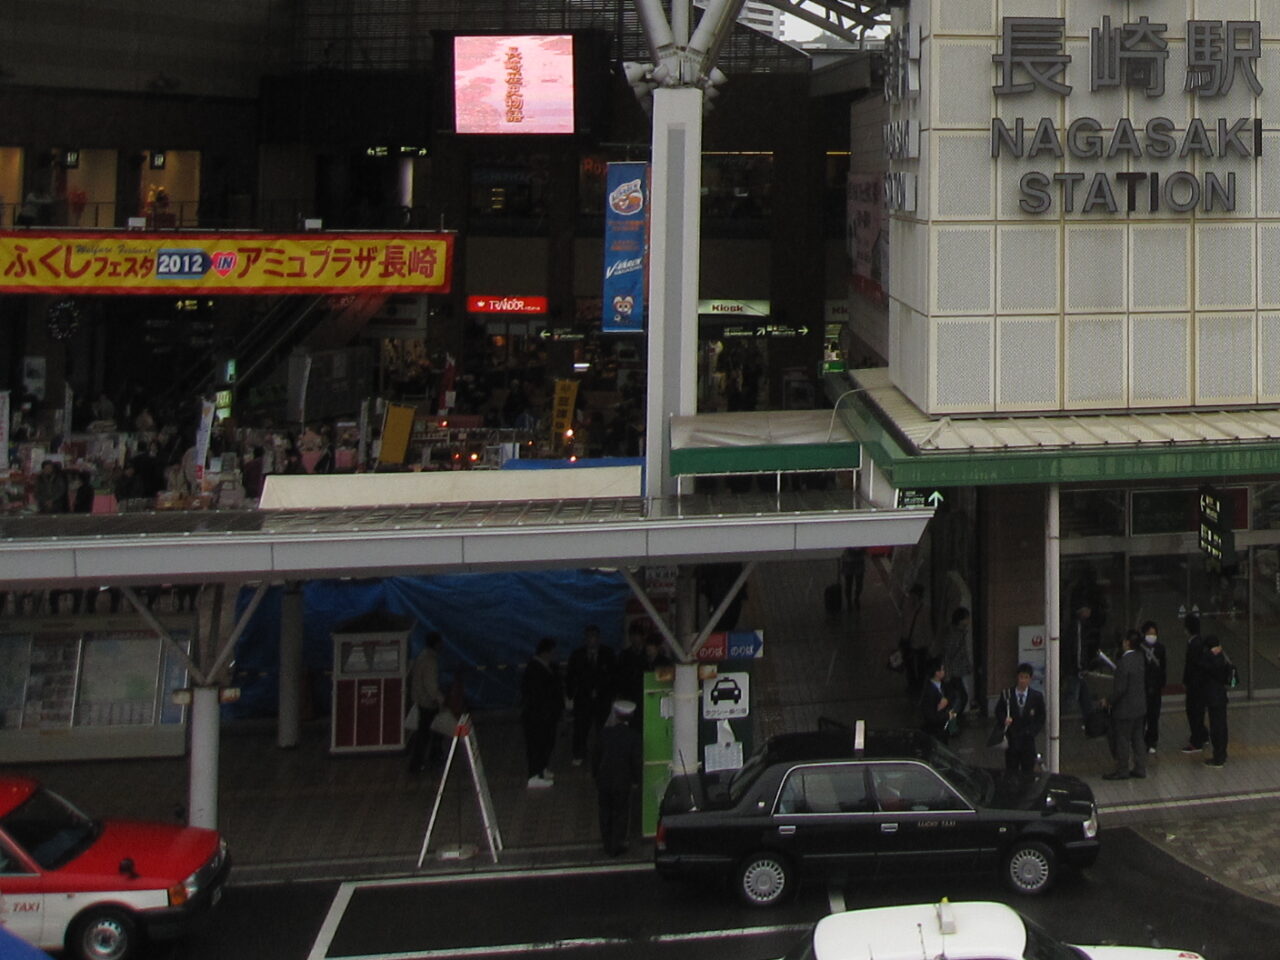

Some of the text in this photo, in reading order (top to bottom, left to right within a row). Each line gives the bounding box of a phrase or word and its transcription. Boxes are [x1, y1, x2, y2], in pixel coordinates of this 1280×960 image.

[991, 15, 1264, 98] 長崎駅
[991, 117, 1264, 159] NAGASAKI
[1019, 171, 1237, 214] STATION
[4, 245, 438, 279] ふくしフェスタ 2012 IN アミュプラザ長崎
[712, 304, 744, 312] Kiosk
[13, 902, 40, 912] TAXI
